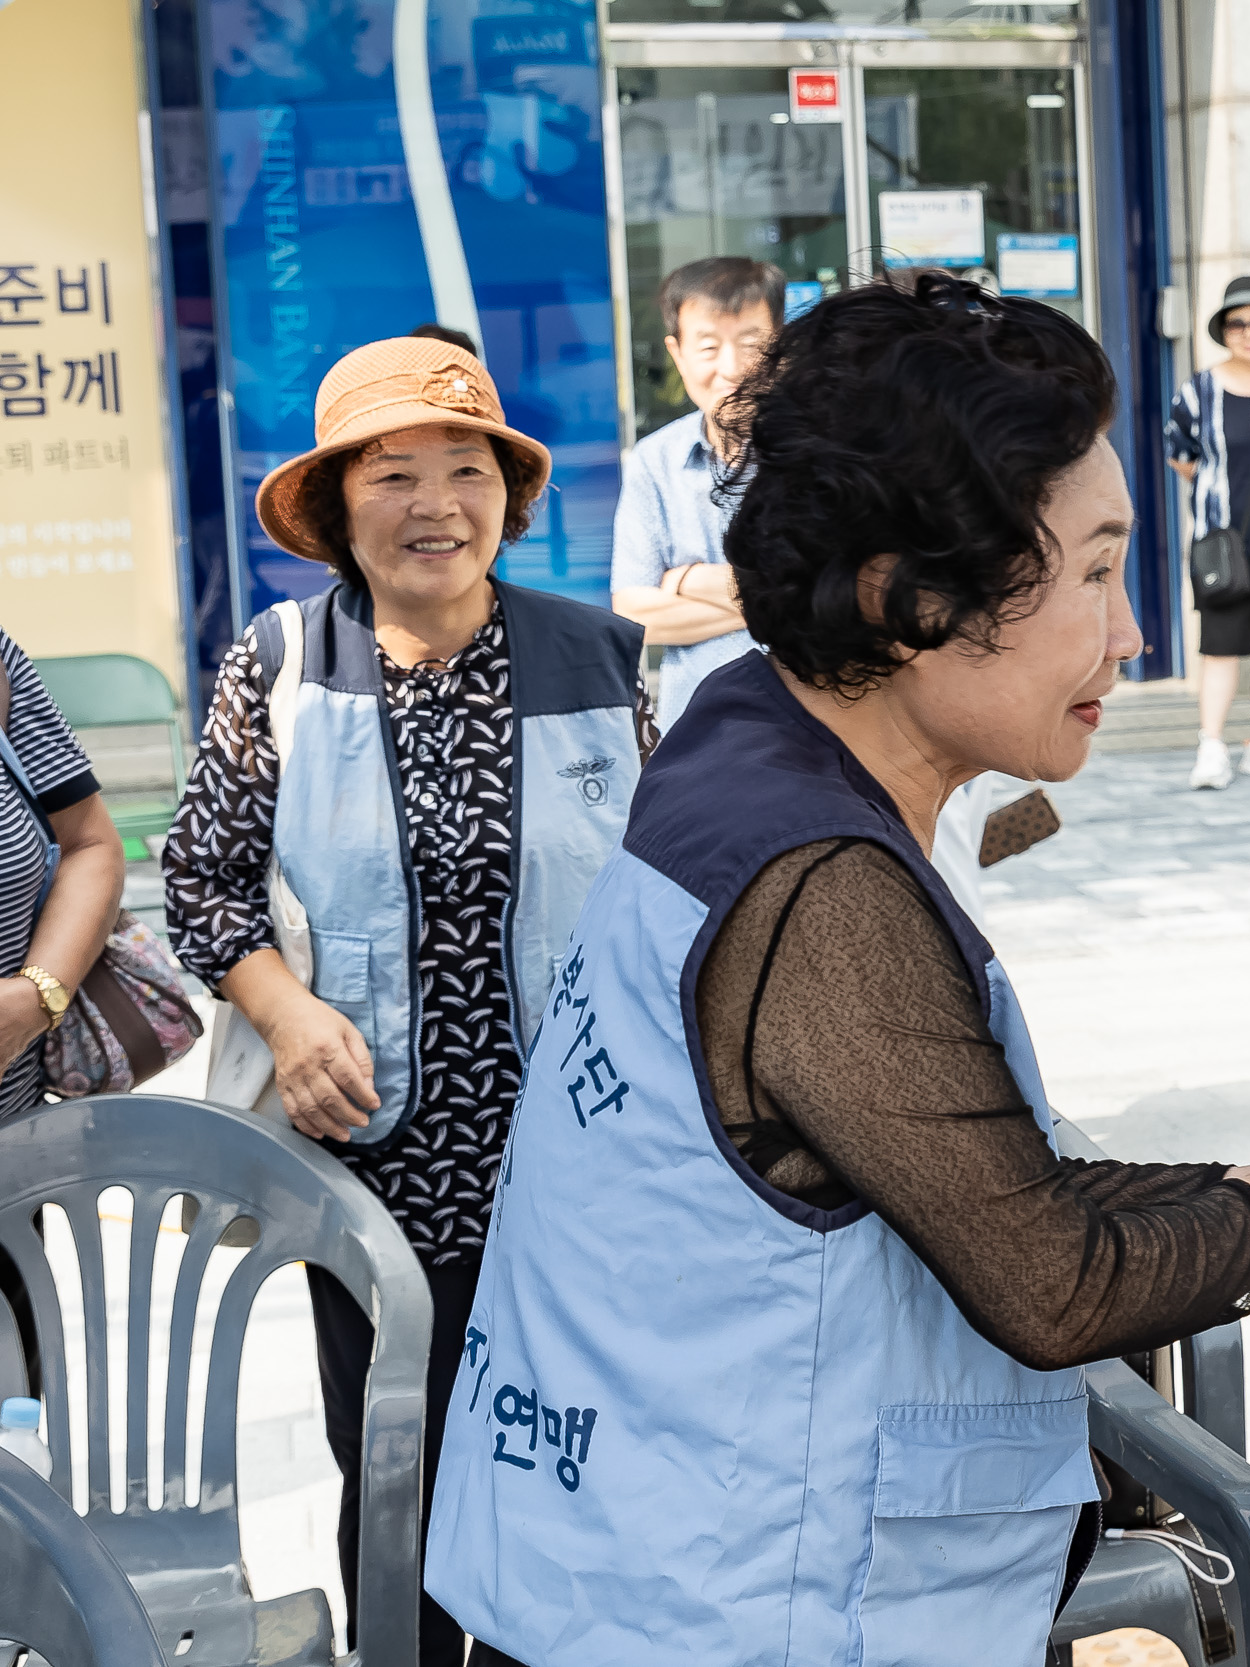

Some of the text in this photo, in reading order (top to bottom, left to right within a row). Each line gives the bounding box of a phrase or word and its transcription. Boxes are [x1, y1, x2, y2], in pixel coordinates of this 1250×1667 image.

[0, 261, 111, 326] 준비
[257, 104, 311, 418] SHINHAN BANK
[0, 351, 120, 417] 함께
[0, 434, 131, 475] 퇴 파트너
